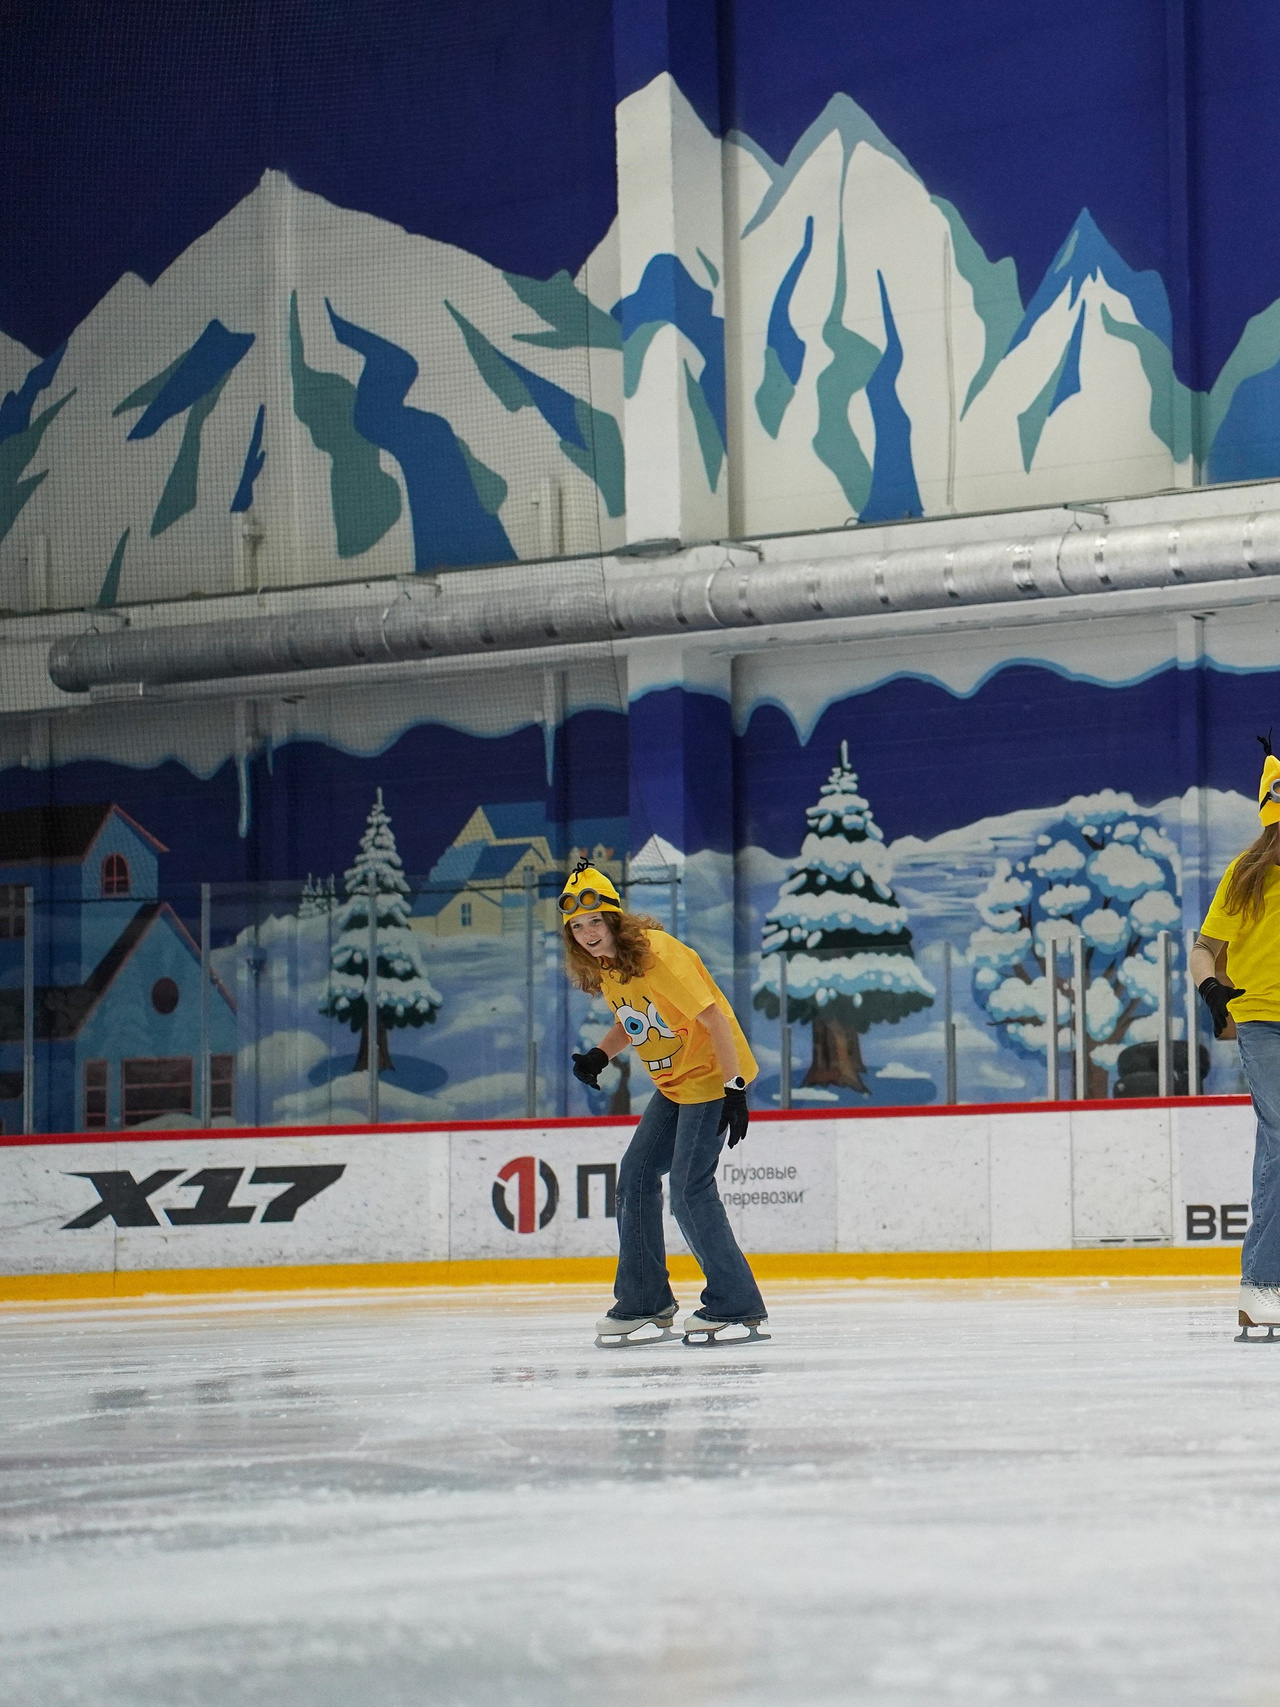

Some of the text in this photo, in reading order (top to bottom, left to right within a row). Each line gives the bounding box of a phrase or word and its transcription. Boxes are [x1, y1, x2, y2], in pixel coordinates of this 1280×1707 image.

[723, 1164, 797, 1184] Грузовые
[60, 1164, 347, 1230] X17
[723, 1190, 804, 1209] перевозки
